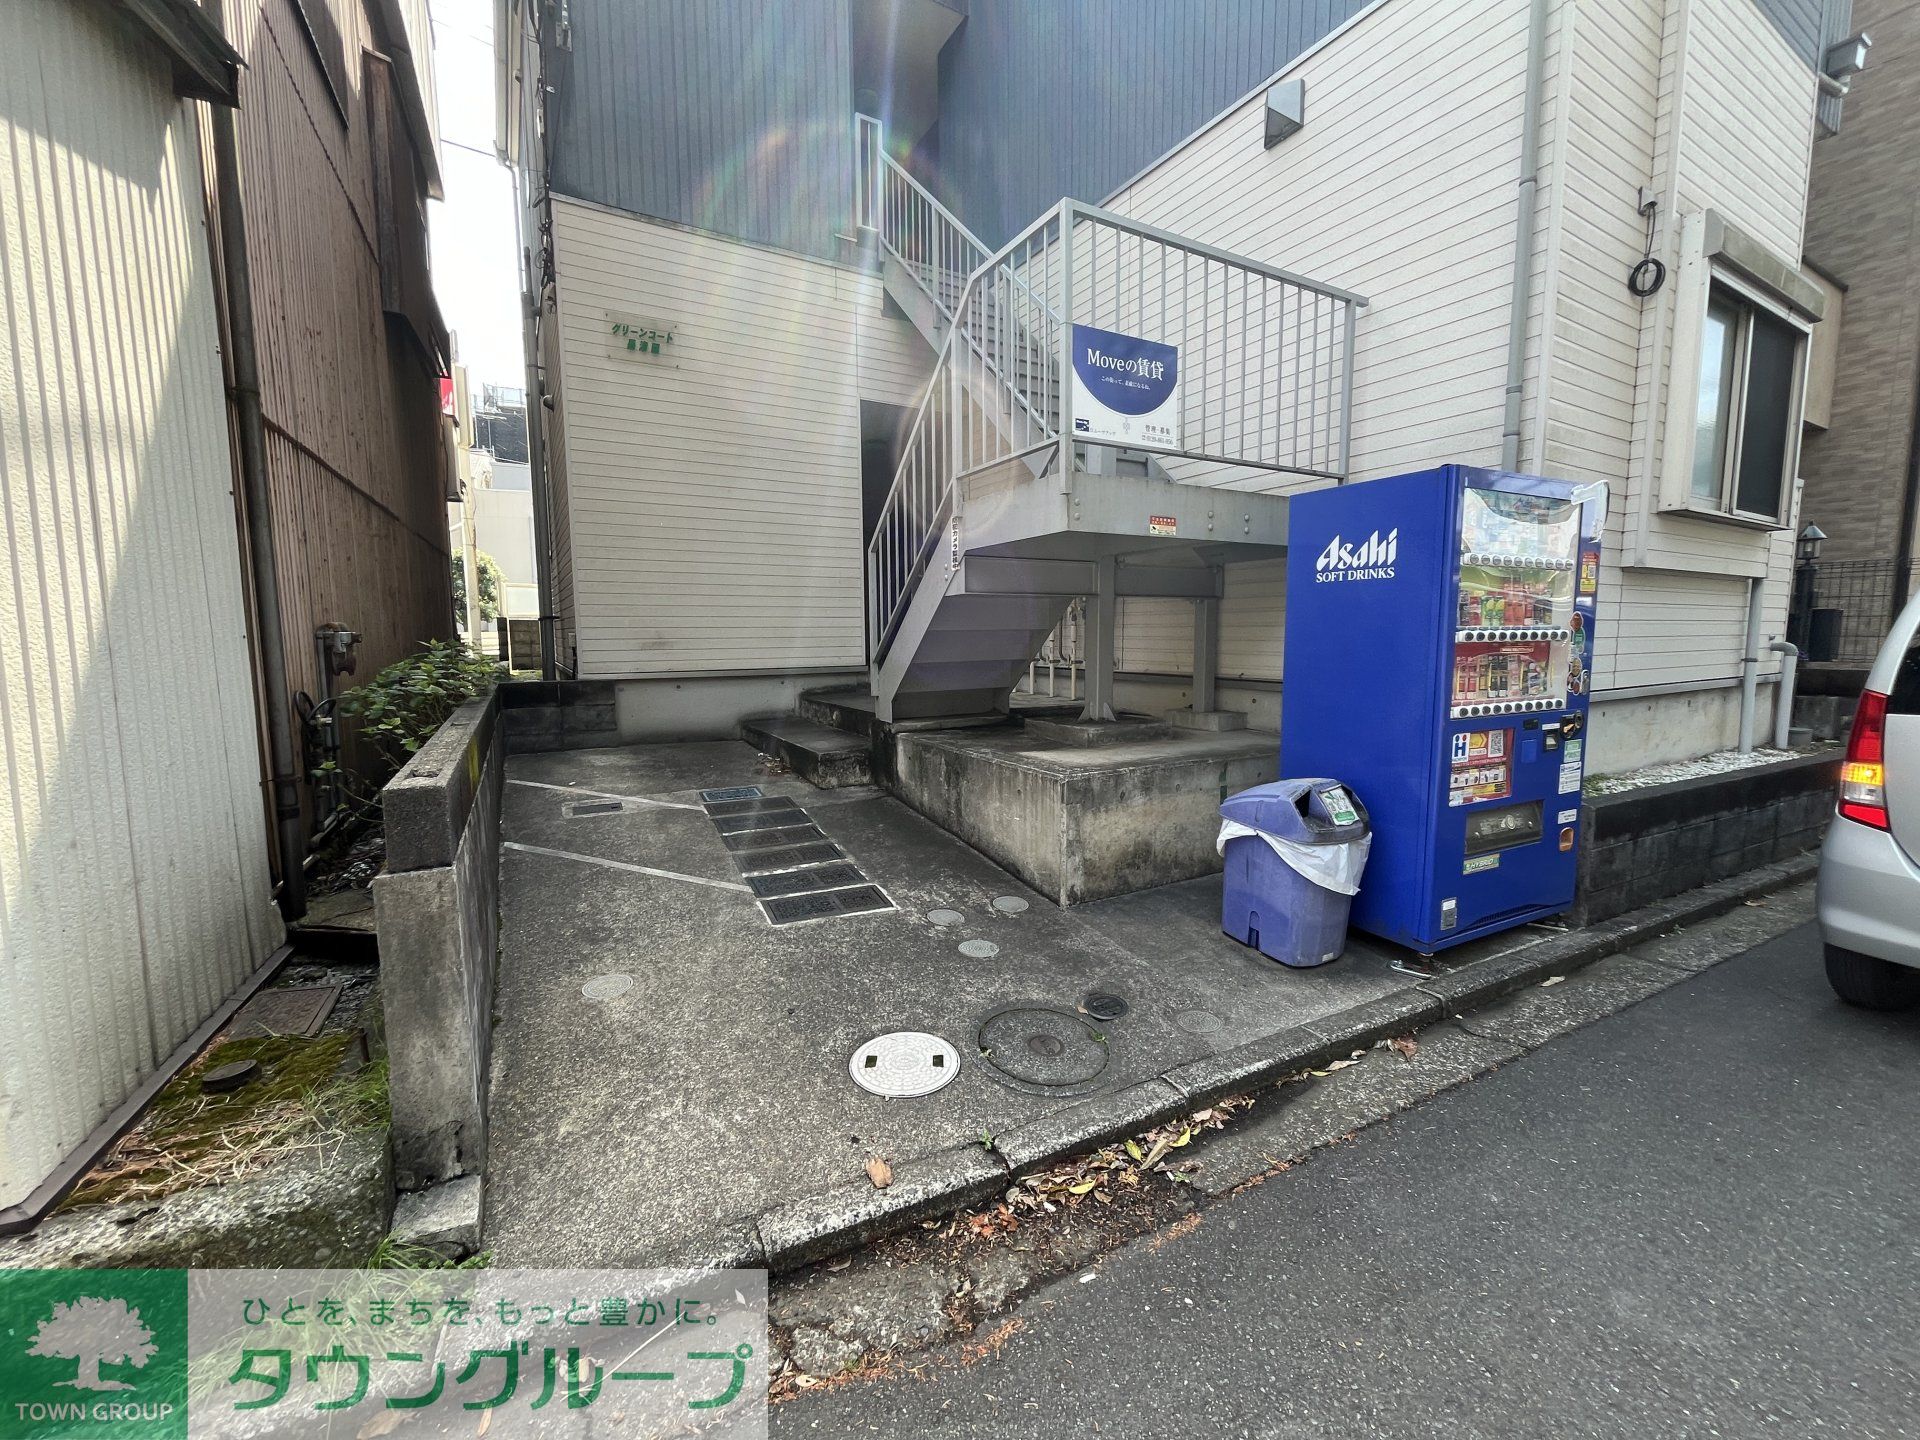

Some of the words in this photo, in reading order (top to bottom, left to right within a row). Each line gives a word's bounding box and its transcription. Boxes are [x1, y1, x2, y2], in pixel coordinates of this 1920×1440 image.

[612, 323, 673, 343] グリーンコート
[1087, 348, 1164, 381] Moveの賃貸
[1316, 527, 1398, 571] Asahi
[1316, 571, 1346, 583] SOFT
[1348, 567, 1395, 581] DRINKS
